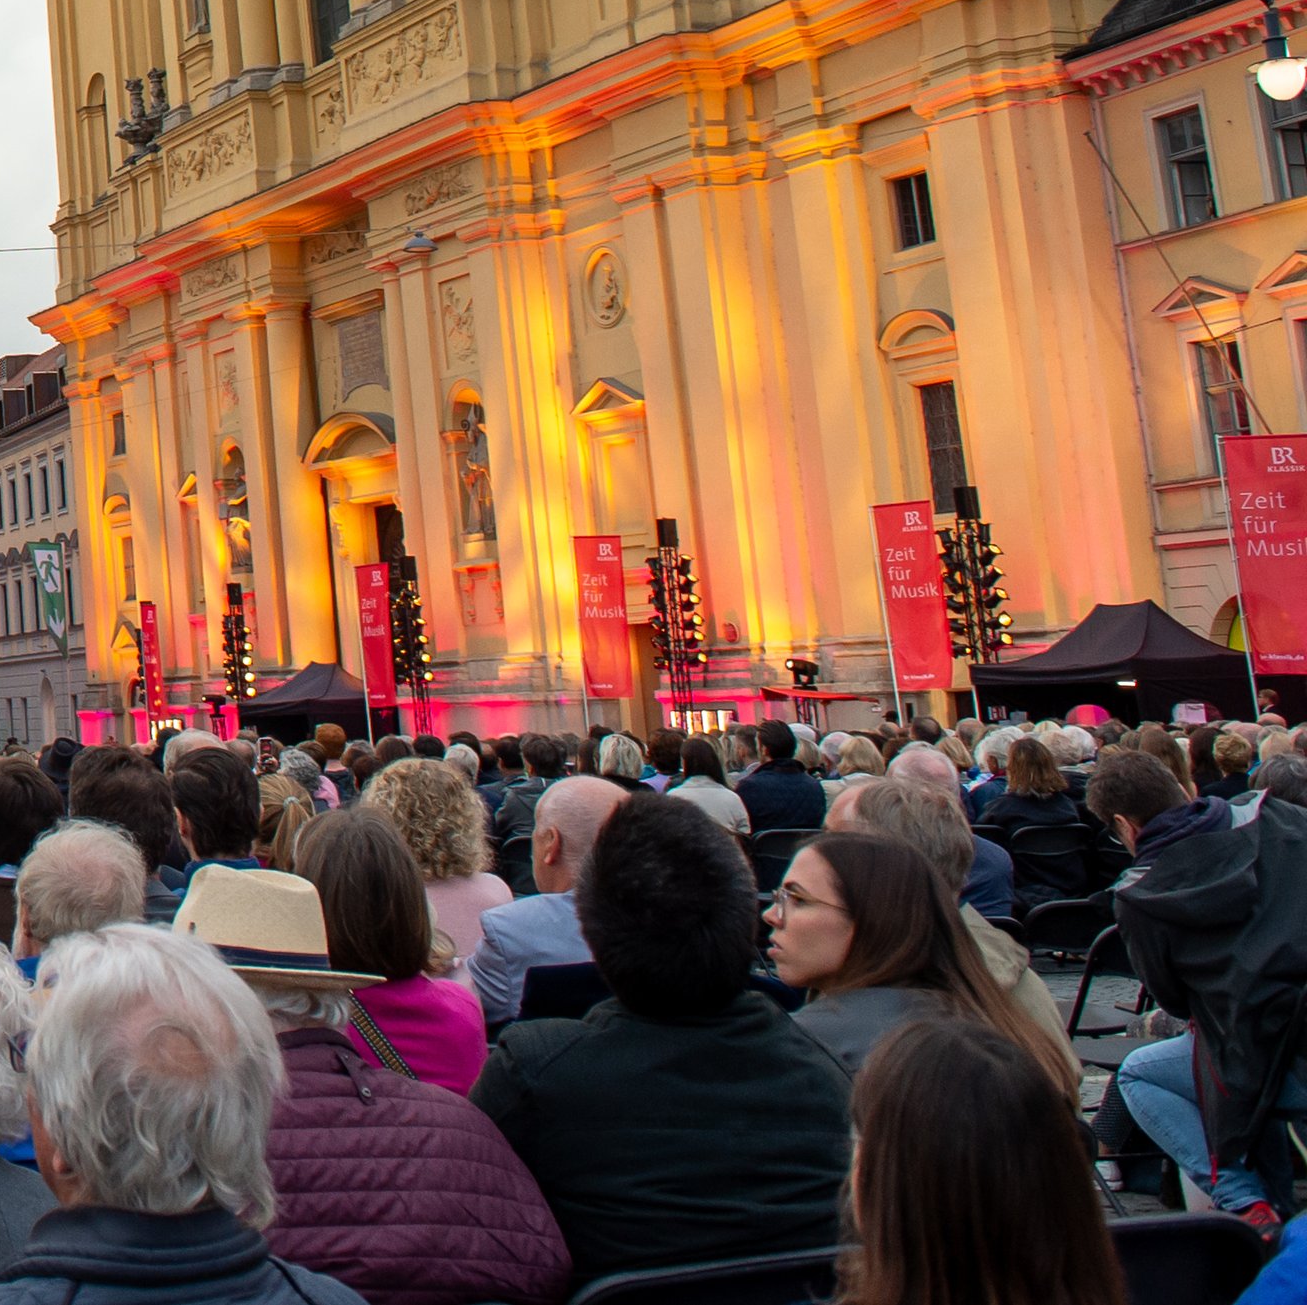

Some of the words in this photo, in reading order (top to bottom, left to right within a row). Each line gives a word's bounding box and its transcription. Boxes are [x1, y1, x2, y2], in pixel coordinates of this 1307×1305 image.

[1271, 447, 1297, 464] BR
[1239, 491, 1286, 510] Zeit
[904, 511, 922, 525] BR
[1243, 515, 1277, 534] für
[598, 543, 613, 556] BR
[885, 546, 916, 562] Zeit
[1247, 538, 1307, 557] Musi
[582, 573, 608, 586] Zeit
[888, 565, 911, 581] für
[583, 590, 603, 603] für
[891, 582, 939, 599] Musik
[585, 605, 625, 618] Musik
